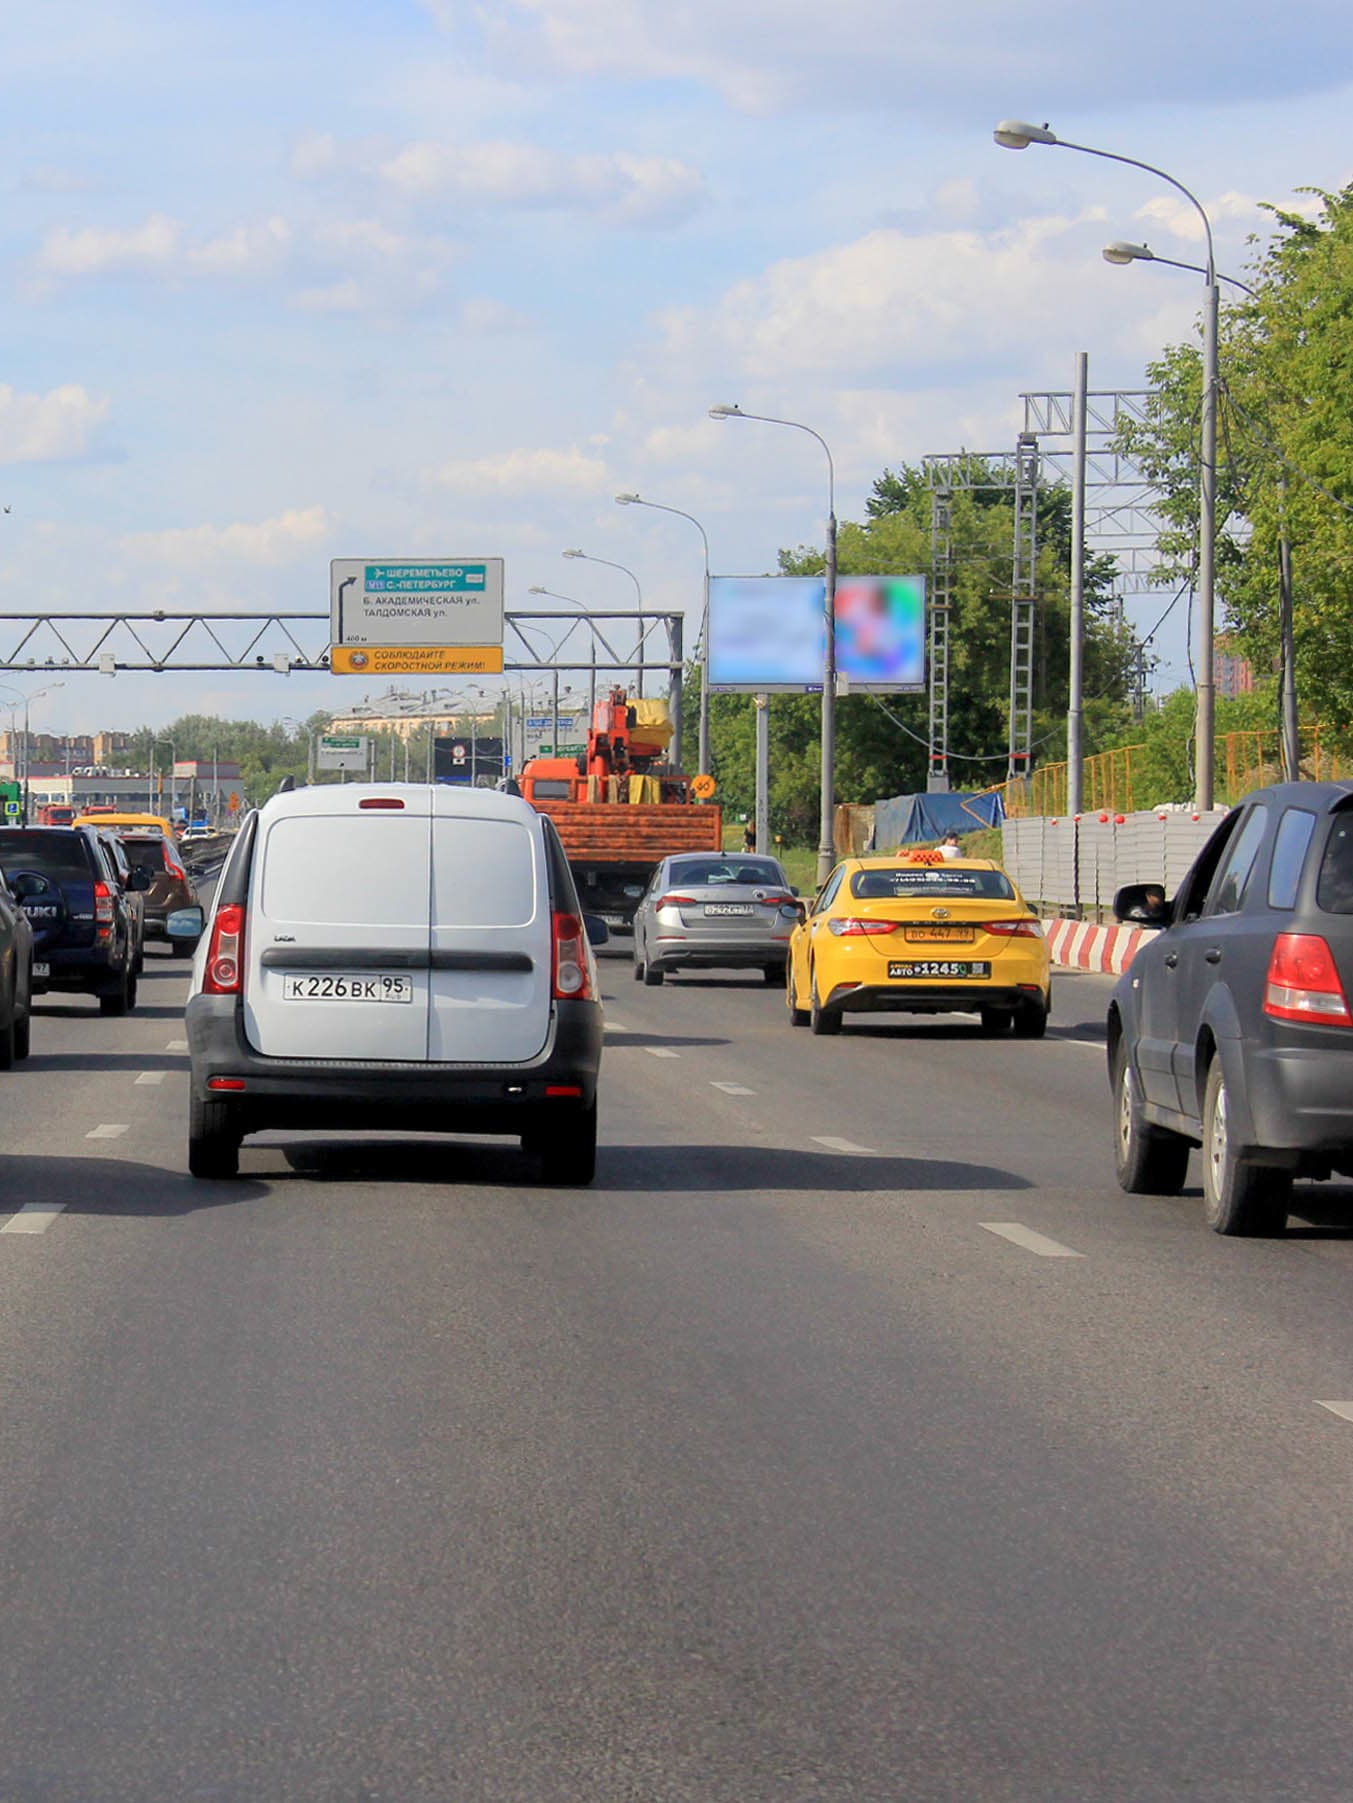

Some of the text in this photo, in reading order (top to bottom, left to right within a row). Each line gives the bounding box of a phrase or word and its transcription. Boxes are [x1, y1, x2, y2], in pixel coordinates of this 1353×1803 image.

[386, 568, 463, 578] ШЕРЕМЕТЬЕВО
[386, 580, 457, 589] С.-ПЕТЕРБУРГ
[363, 596, 480, 606] Б. АКАДЕМИЧЕСКАЯ ул.
[364, 608, 447, 618] ТАЛДОМСКАЯ ул.
[374, 650, 446, 660] СОБЛЮДАЙТЕ
[374, 660, 486, 670] СКОРОСТНОЙ РЕЖИМ!
[890, 968, 913, 976] АВТО
[382, 977, 403, 993] 95
